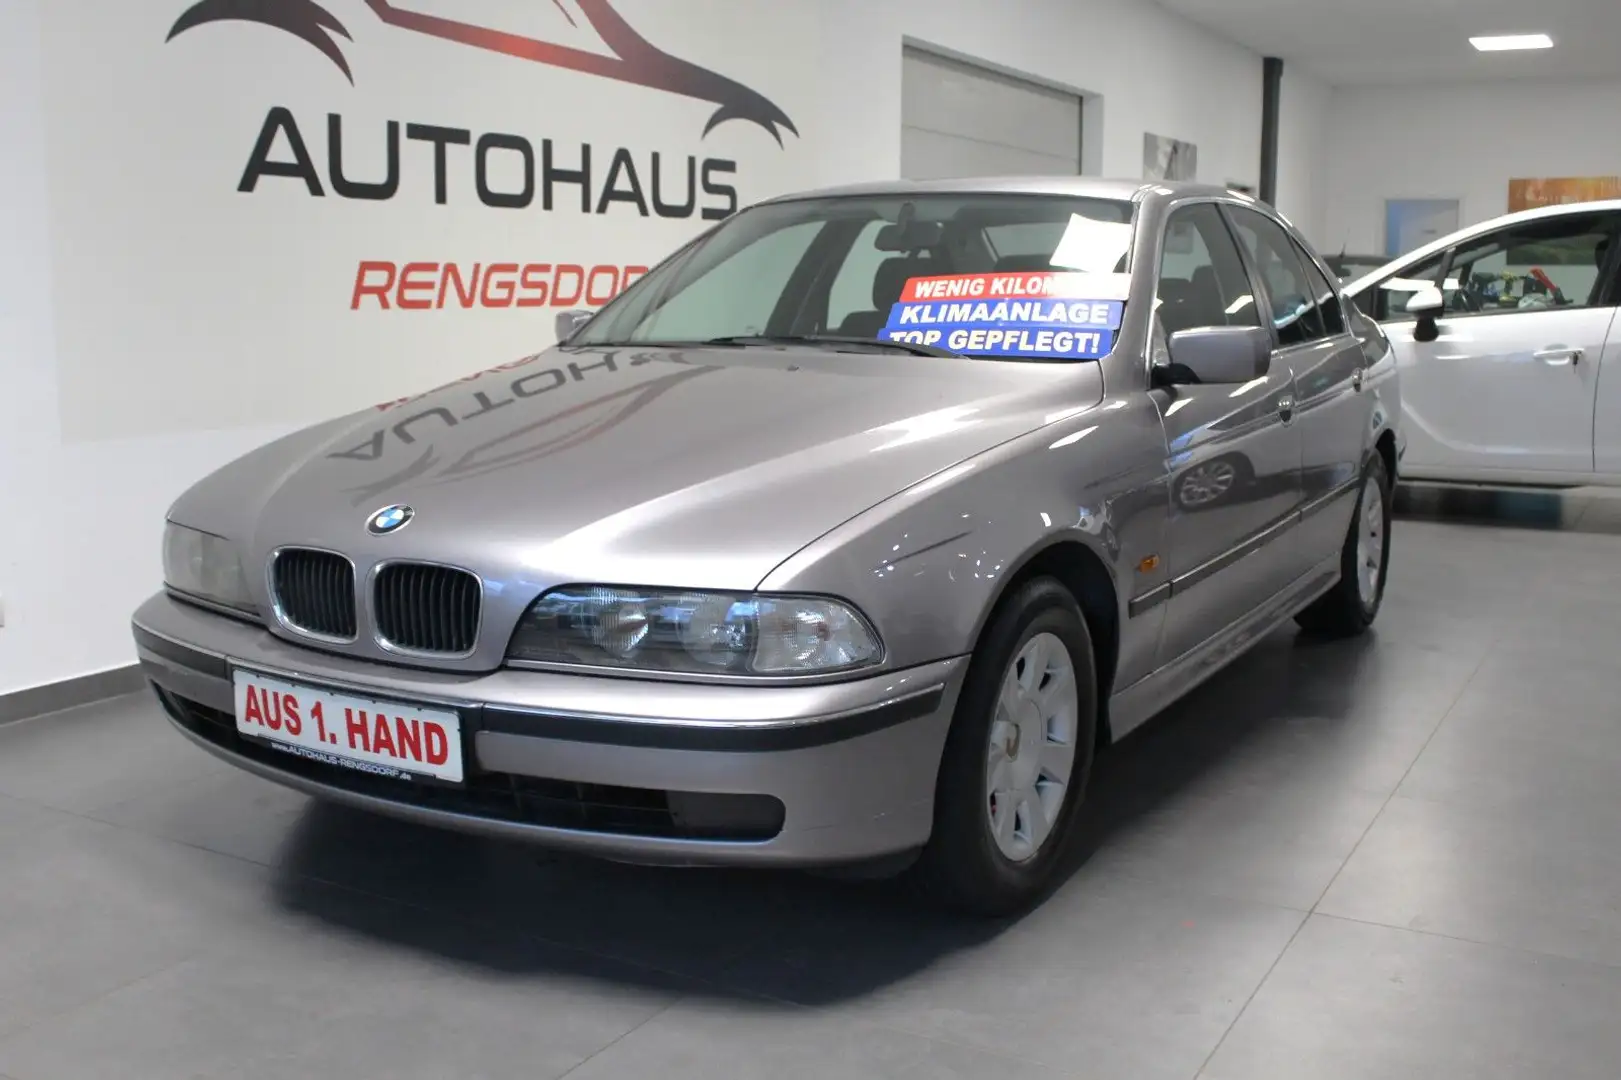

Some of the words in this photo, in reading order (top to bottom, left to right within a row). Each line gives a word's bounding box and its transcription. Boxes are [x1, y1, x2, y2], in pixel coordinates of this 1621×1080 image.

[237, 106, 737, 220] AUTOHAUS
[914, 278, 985, 298] WENIG
[900, 302, 1109, 325] KLIMAANLAGE
[889, 330, 941, 346] TOP
[948, 330, 1101, 354] GEPFLEGT!
[245, 684, 302, 736] AUS
[310, 701, 338, 745] 1.
[344, 708, 449, 766] HAND
